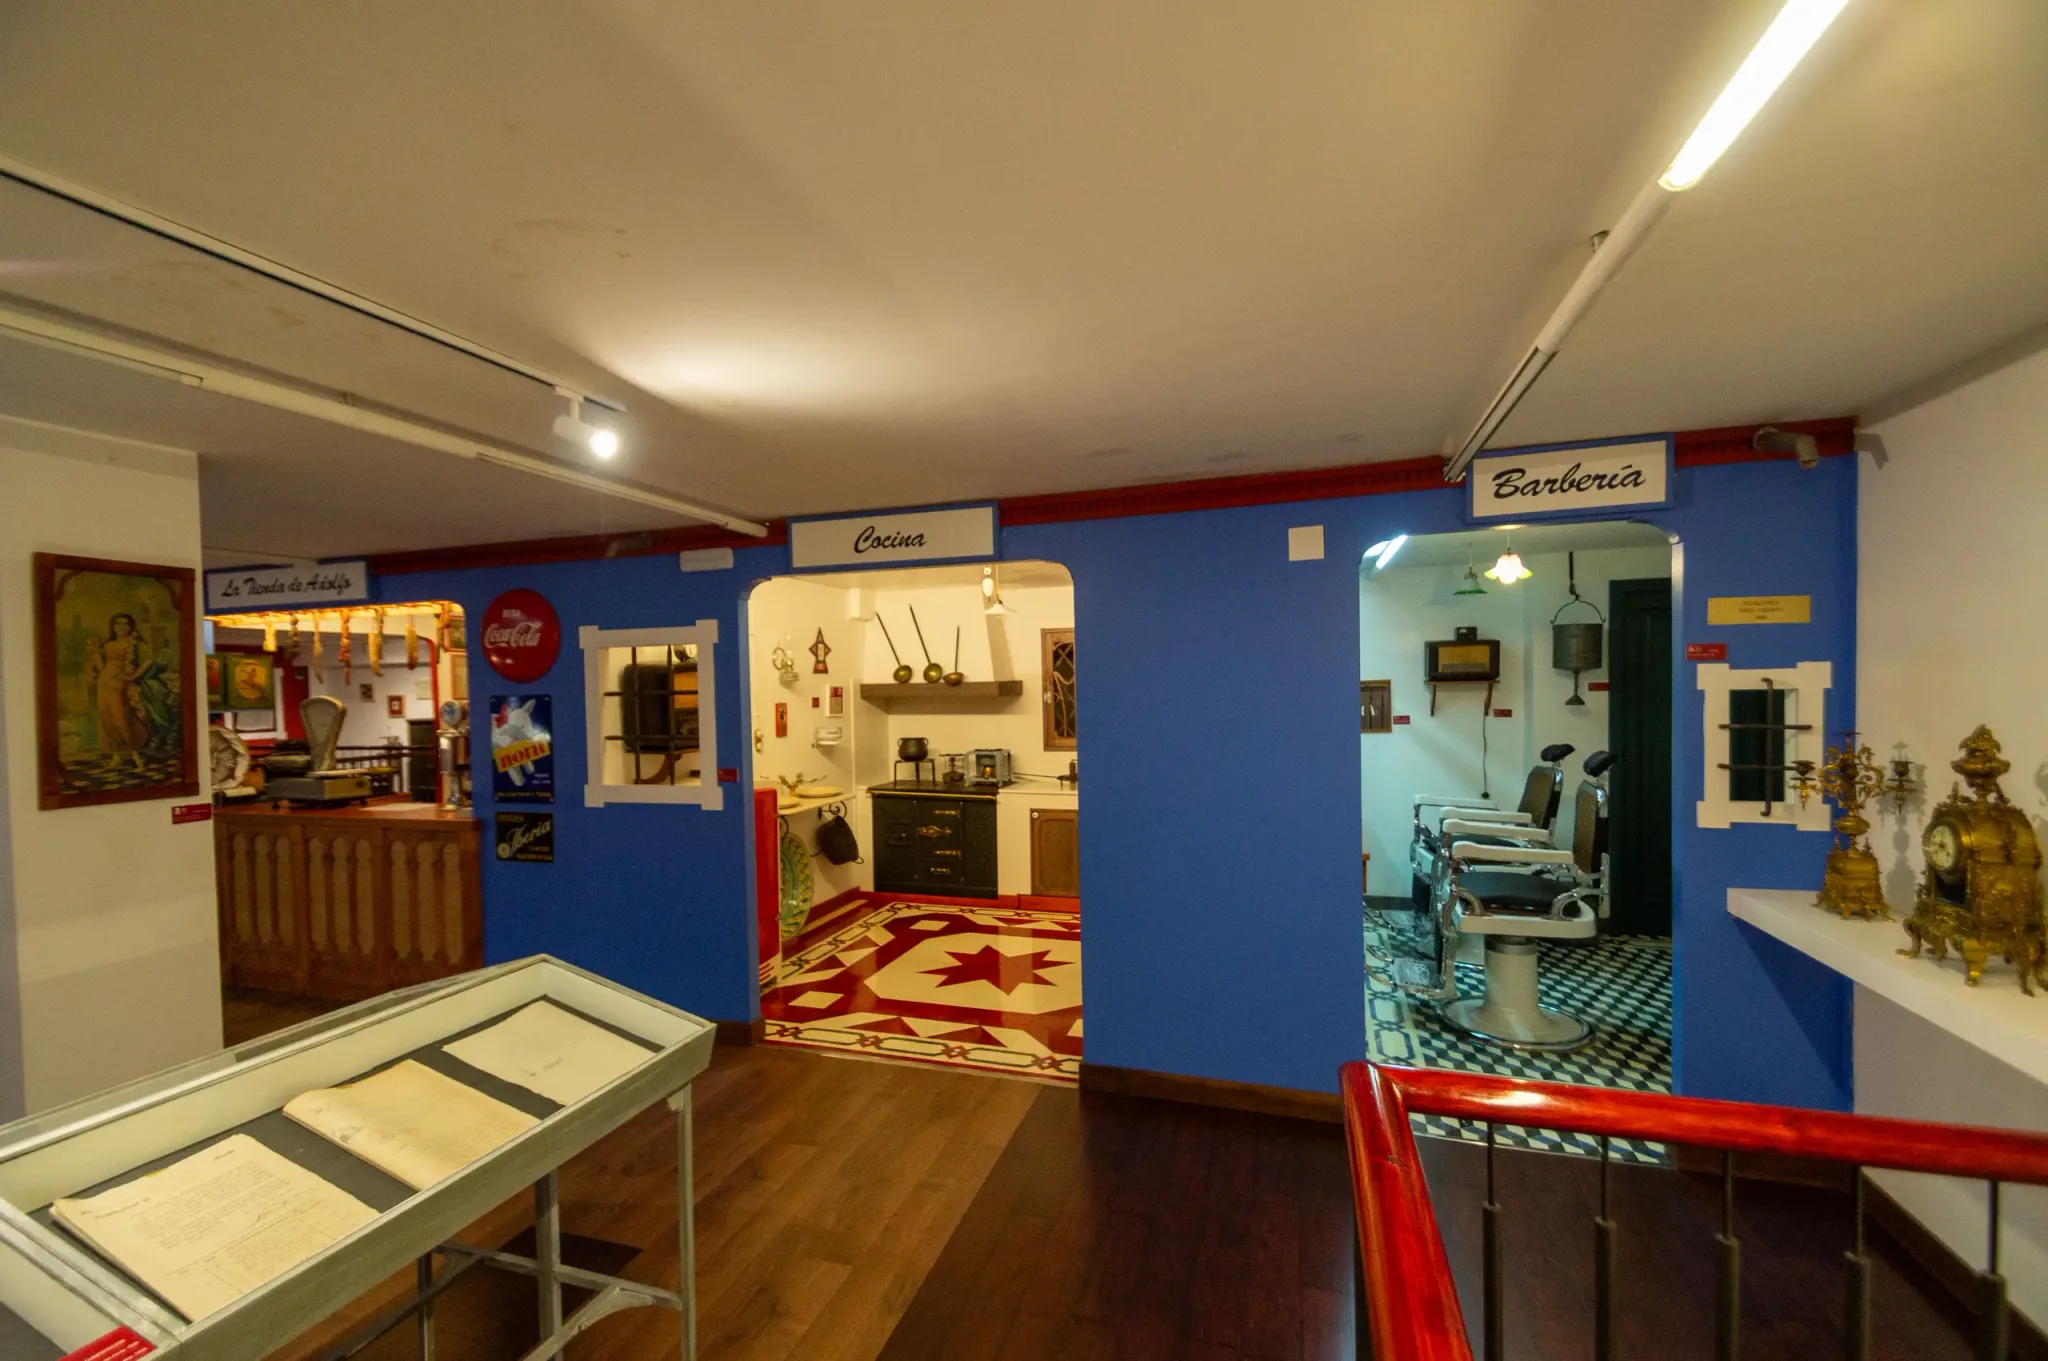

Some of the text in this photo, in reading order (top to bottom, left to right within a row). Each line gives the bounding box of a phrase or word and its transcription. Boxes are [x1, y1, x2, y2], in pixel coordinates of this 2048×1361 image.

[1492, 462, 1646, 499] Barbería
[853, 525, 927, 554] Cocina
[221, 572, 351, 597] La Tienda de Adolfo
